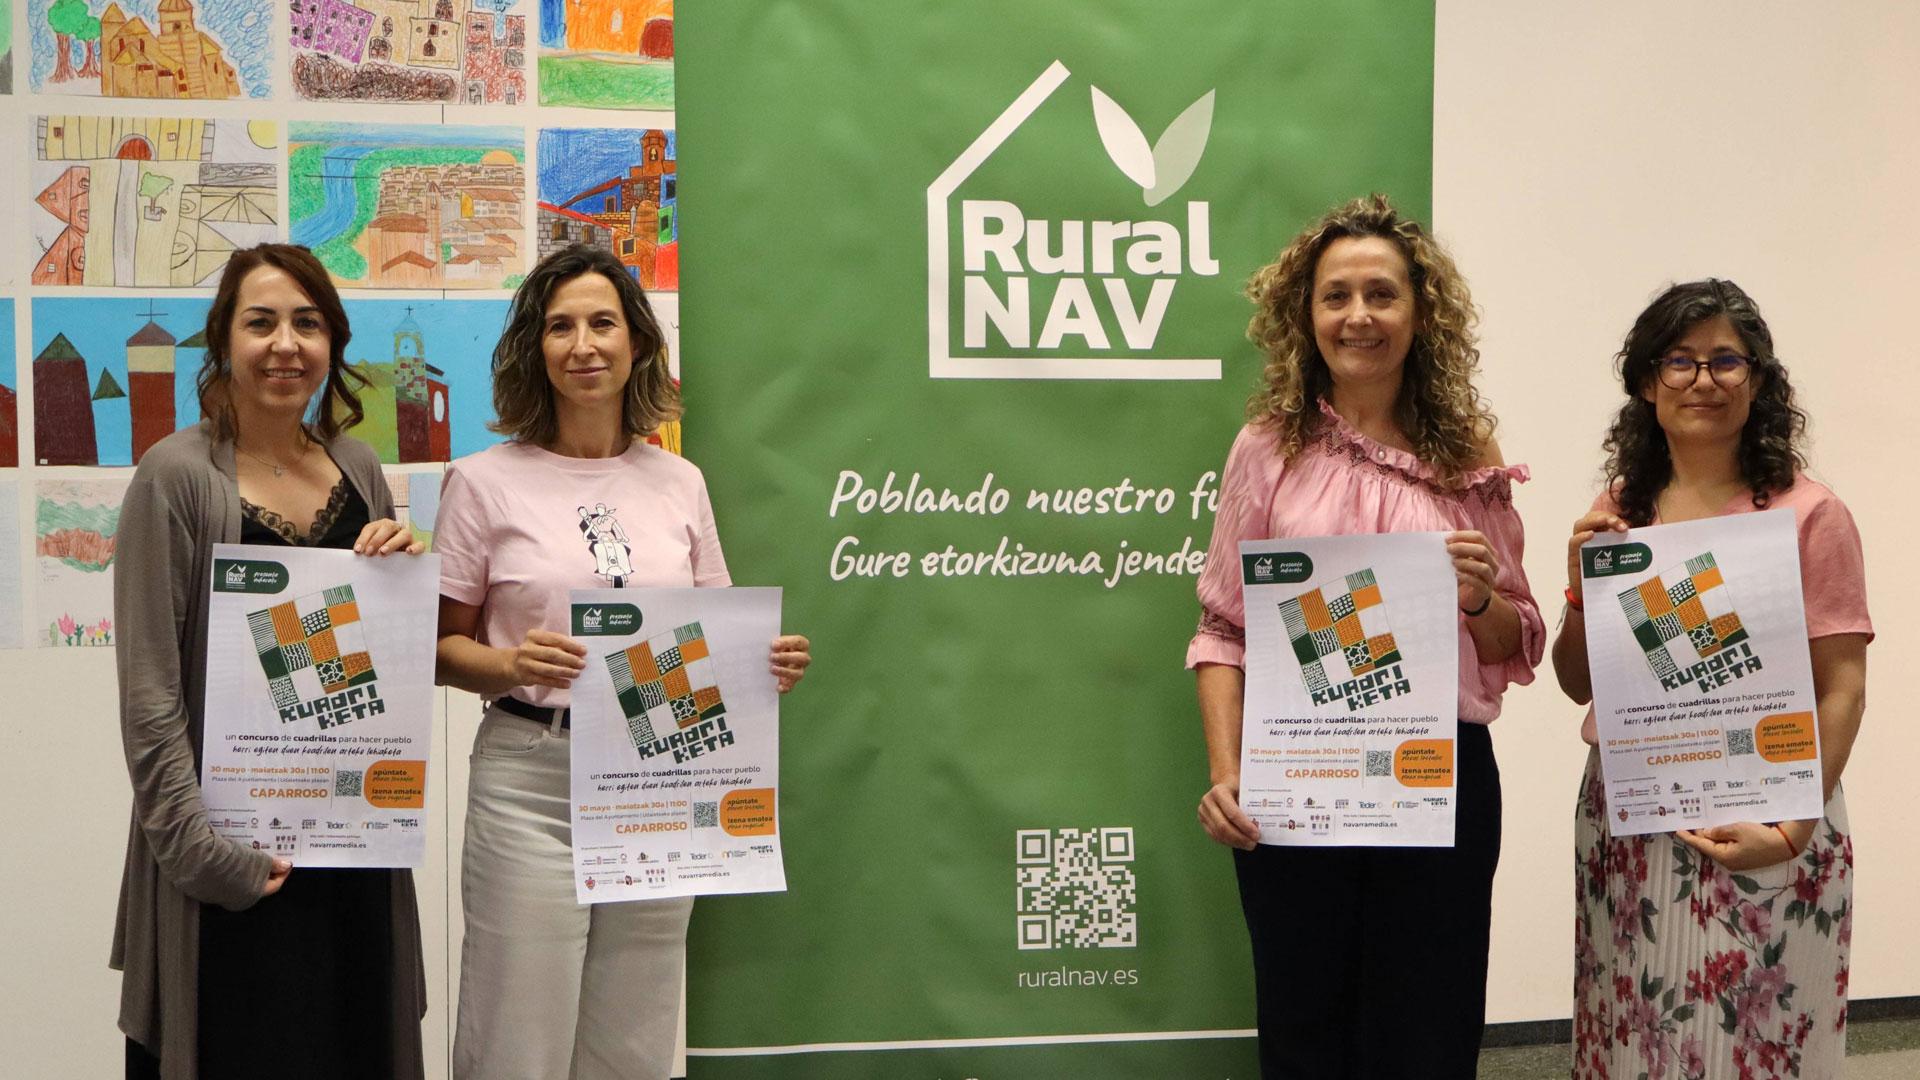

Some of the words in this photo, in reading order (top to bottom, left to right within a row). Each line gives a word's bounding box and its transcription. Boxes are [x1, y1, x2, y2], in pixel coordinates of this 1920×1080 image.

[964, 200, 1219, 276] Rural
[965, 277, 1177, 350] NAV
[829, 470, 1011, 518] Poblando
[1026, 477, 1175, 515] nuestro
[829, 535, 911, 581] Gure
[920, 537, 1104, 577] etorkizuna
[1104, 536, 1208, 588] jende
[1627, 704, 1665, 713] concurso
[1678, 698, 1720, 708] cuadrillas
[1742, 693, 1765, 701] hacer
[1766, 690, 1795, 700] pueblo
[1411, 716, 1438, 724] pueblo
[1762, 722, 1796, 732] apúntate
[294, 735, 337, 743] cuadrillas
[384, 737, 412, 745] pueblo
[1619, 738, 1640, 747] mayo
[1644, 734, 1679, 743] maiatzak
[1701, 729, 1719, 737] 11:00
[1402, 748, 1435, 756] apúntate
[1647, 750, 1723, 766] CAPARROSO
[373, 769, 407, 777] apúntate
[652, 769, 691, 777] cuadrillas
[734, 767, 761, 775] pueblo
[1286, 769, 1359, 779] CAPARROSO
[250, 788, 328, 799] CAPARROSO
[727, 797, 758, 806] apúntate
[1714, 797, 1767, 809] navarramedia.es
[579, 804, 588, 812] 30
[589, 804, 611, 812] mayo
[616, 821, 688, 833] CAPARROSO
[1343, 821, 1398, 829] navarramedia.es
[310, 841, 367, 849] navarramedia.es
[678, 871, 730, 879] navarramedia.es
[1018, 966, 1138, 988] ruralnav.es
